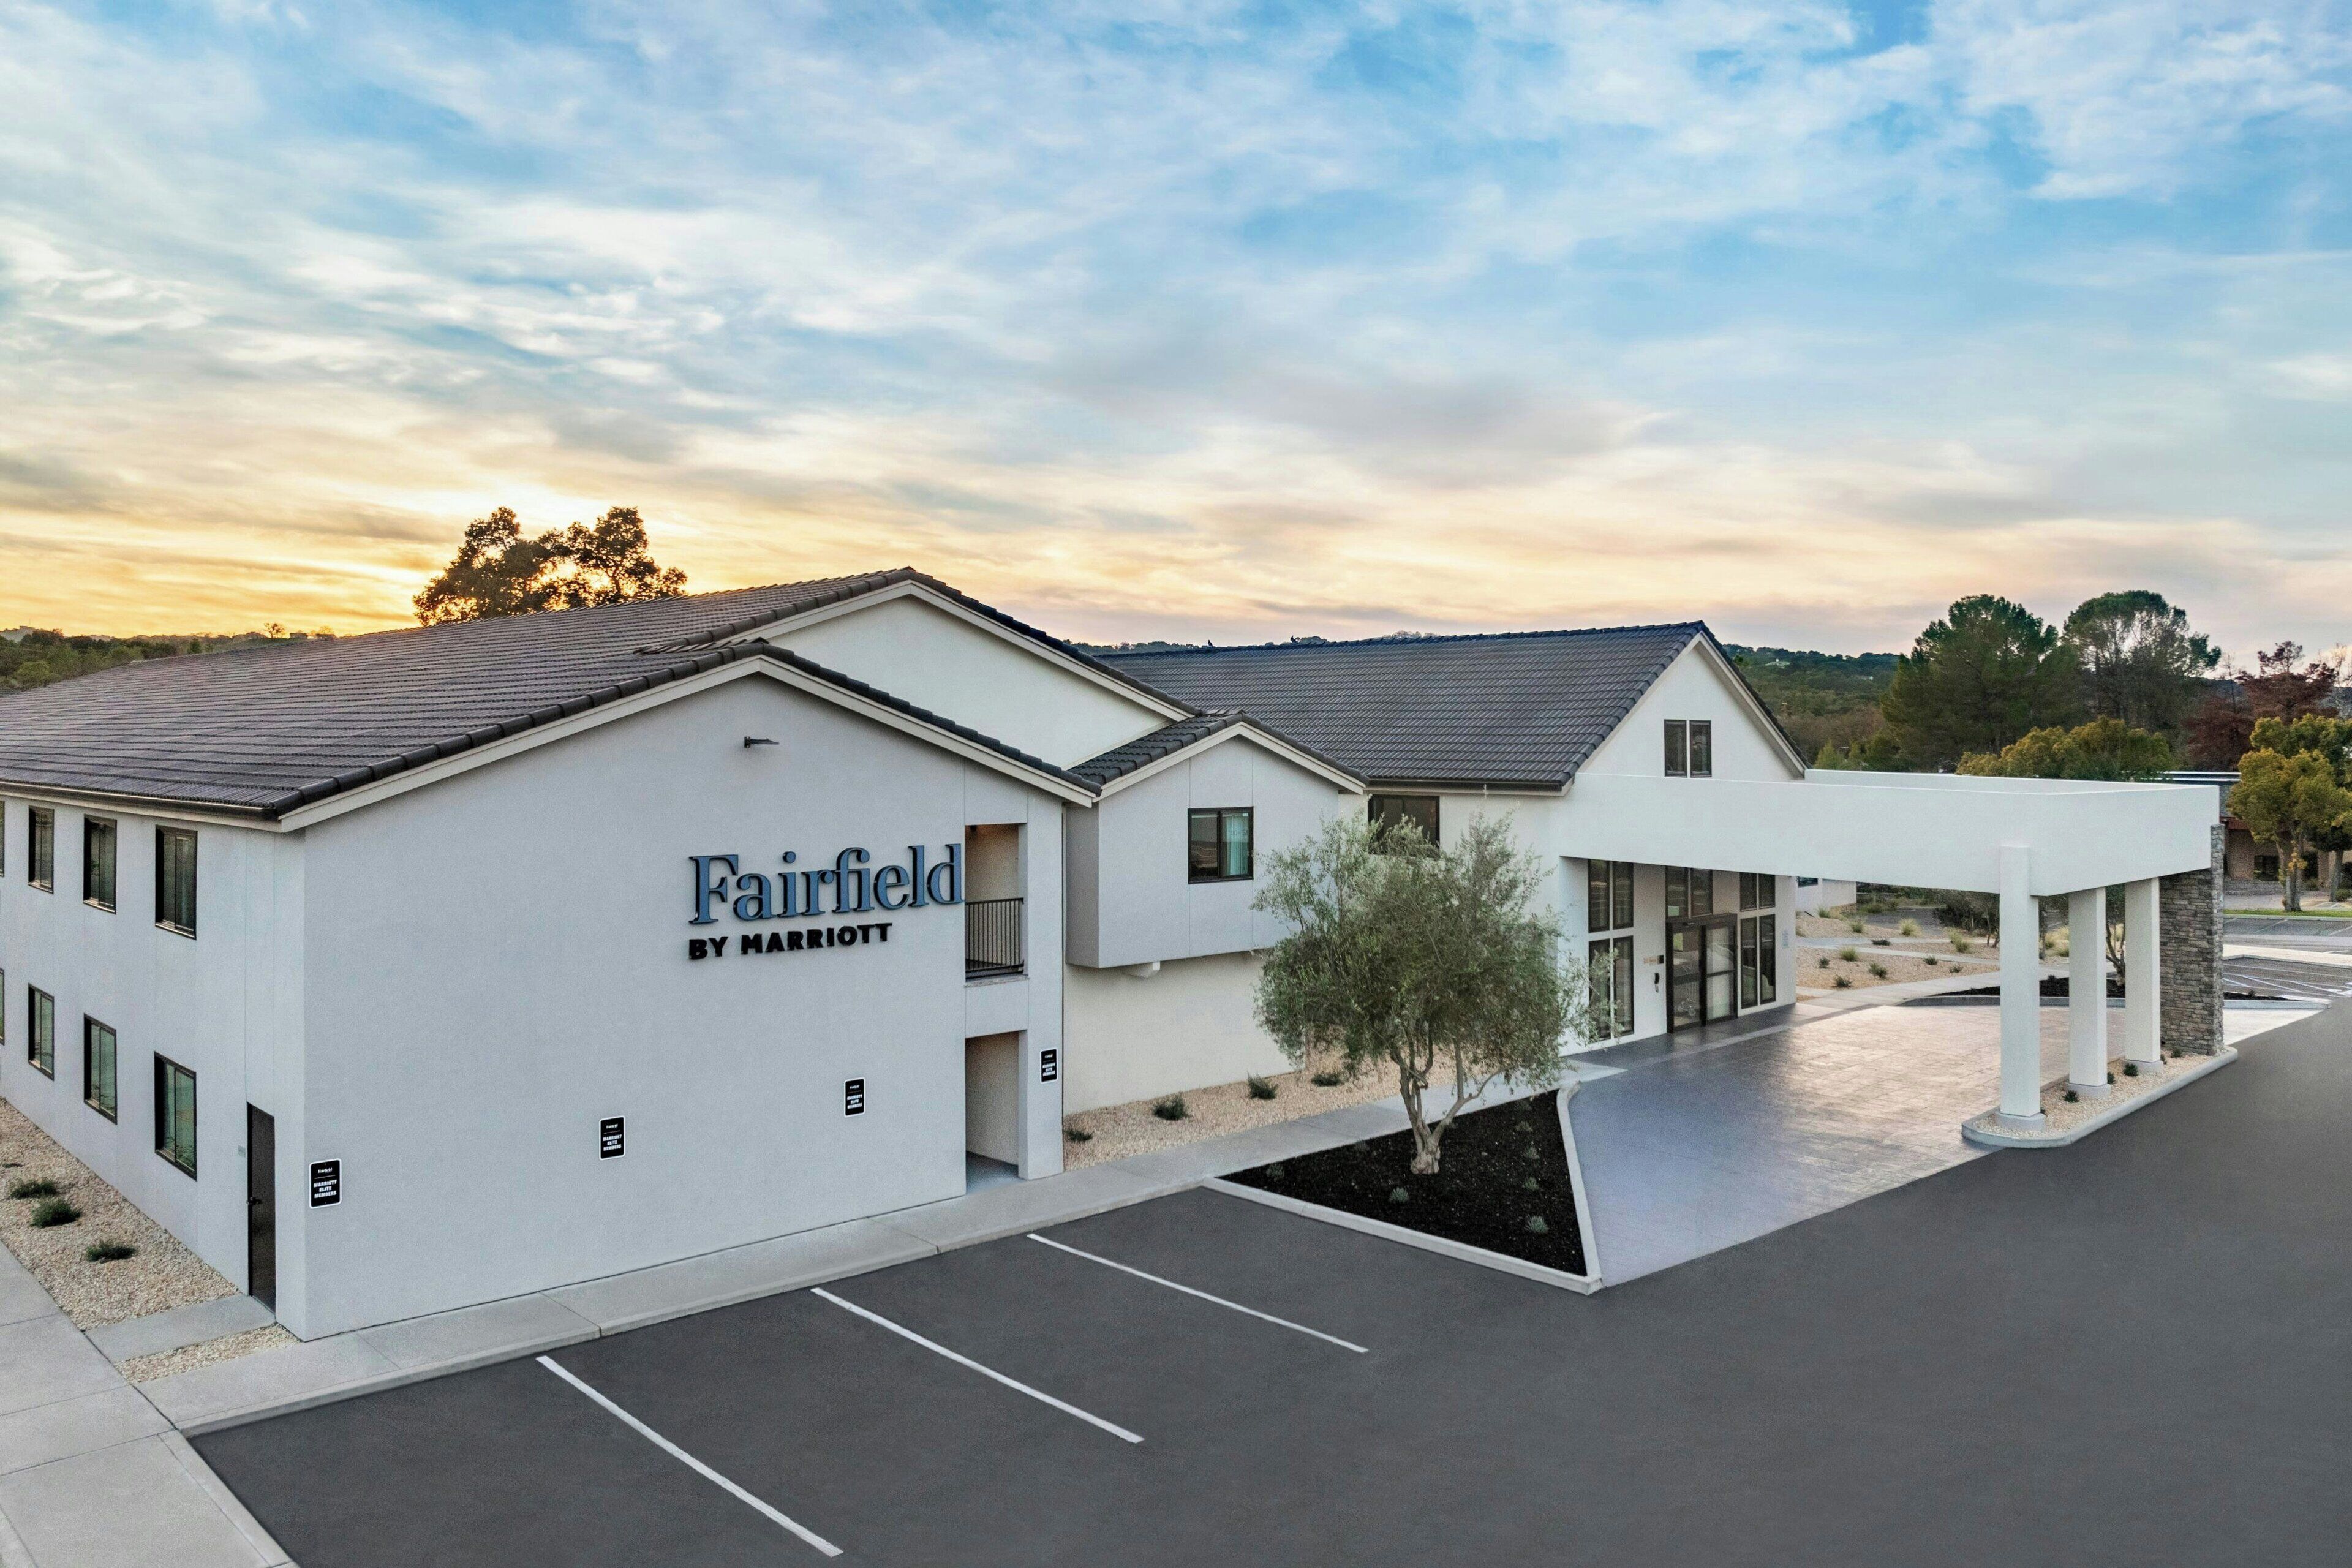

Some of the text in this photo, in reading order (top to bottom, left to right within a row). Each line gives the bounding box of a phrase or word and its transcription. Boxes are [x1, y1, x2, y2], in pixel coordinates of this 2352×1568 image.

[688, 843, 965, 925] Fairfield
[689, 922, 892, 960] BY MARRIOTT
[313, 1179, 337, 1188] MARRIOTT
[314, 1190, 337, 1199] MEMBERS
